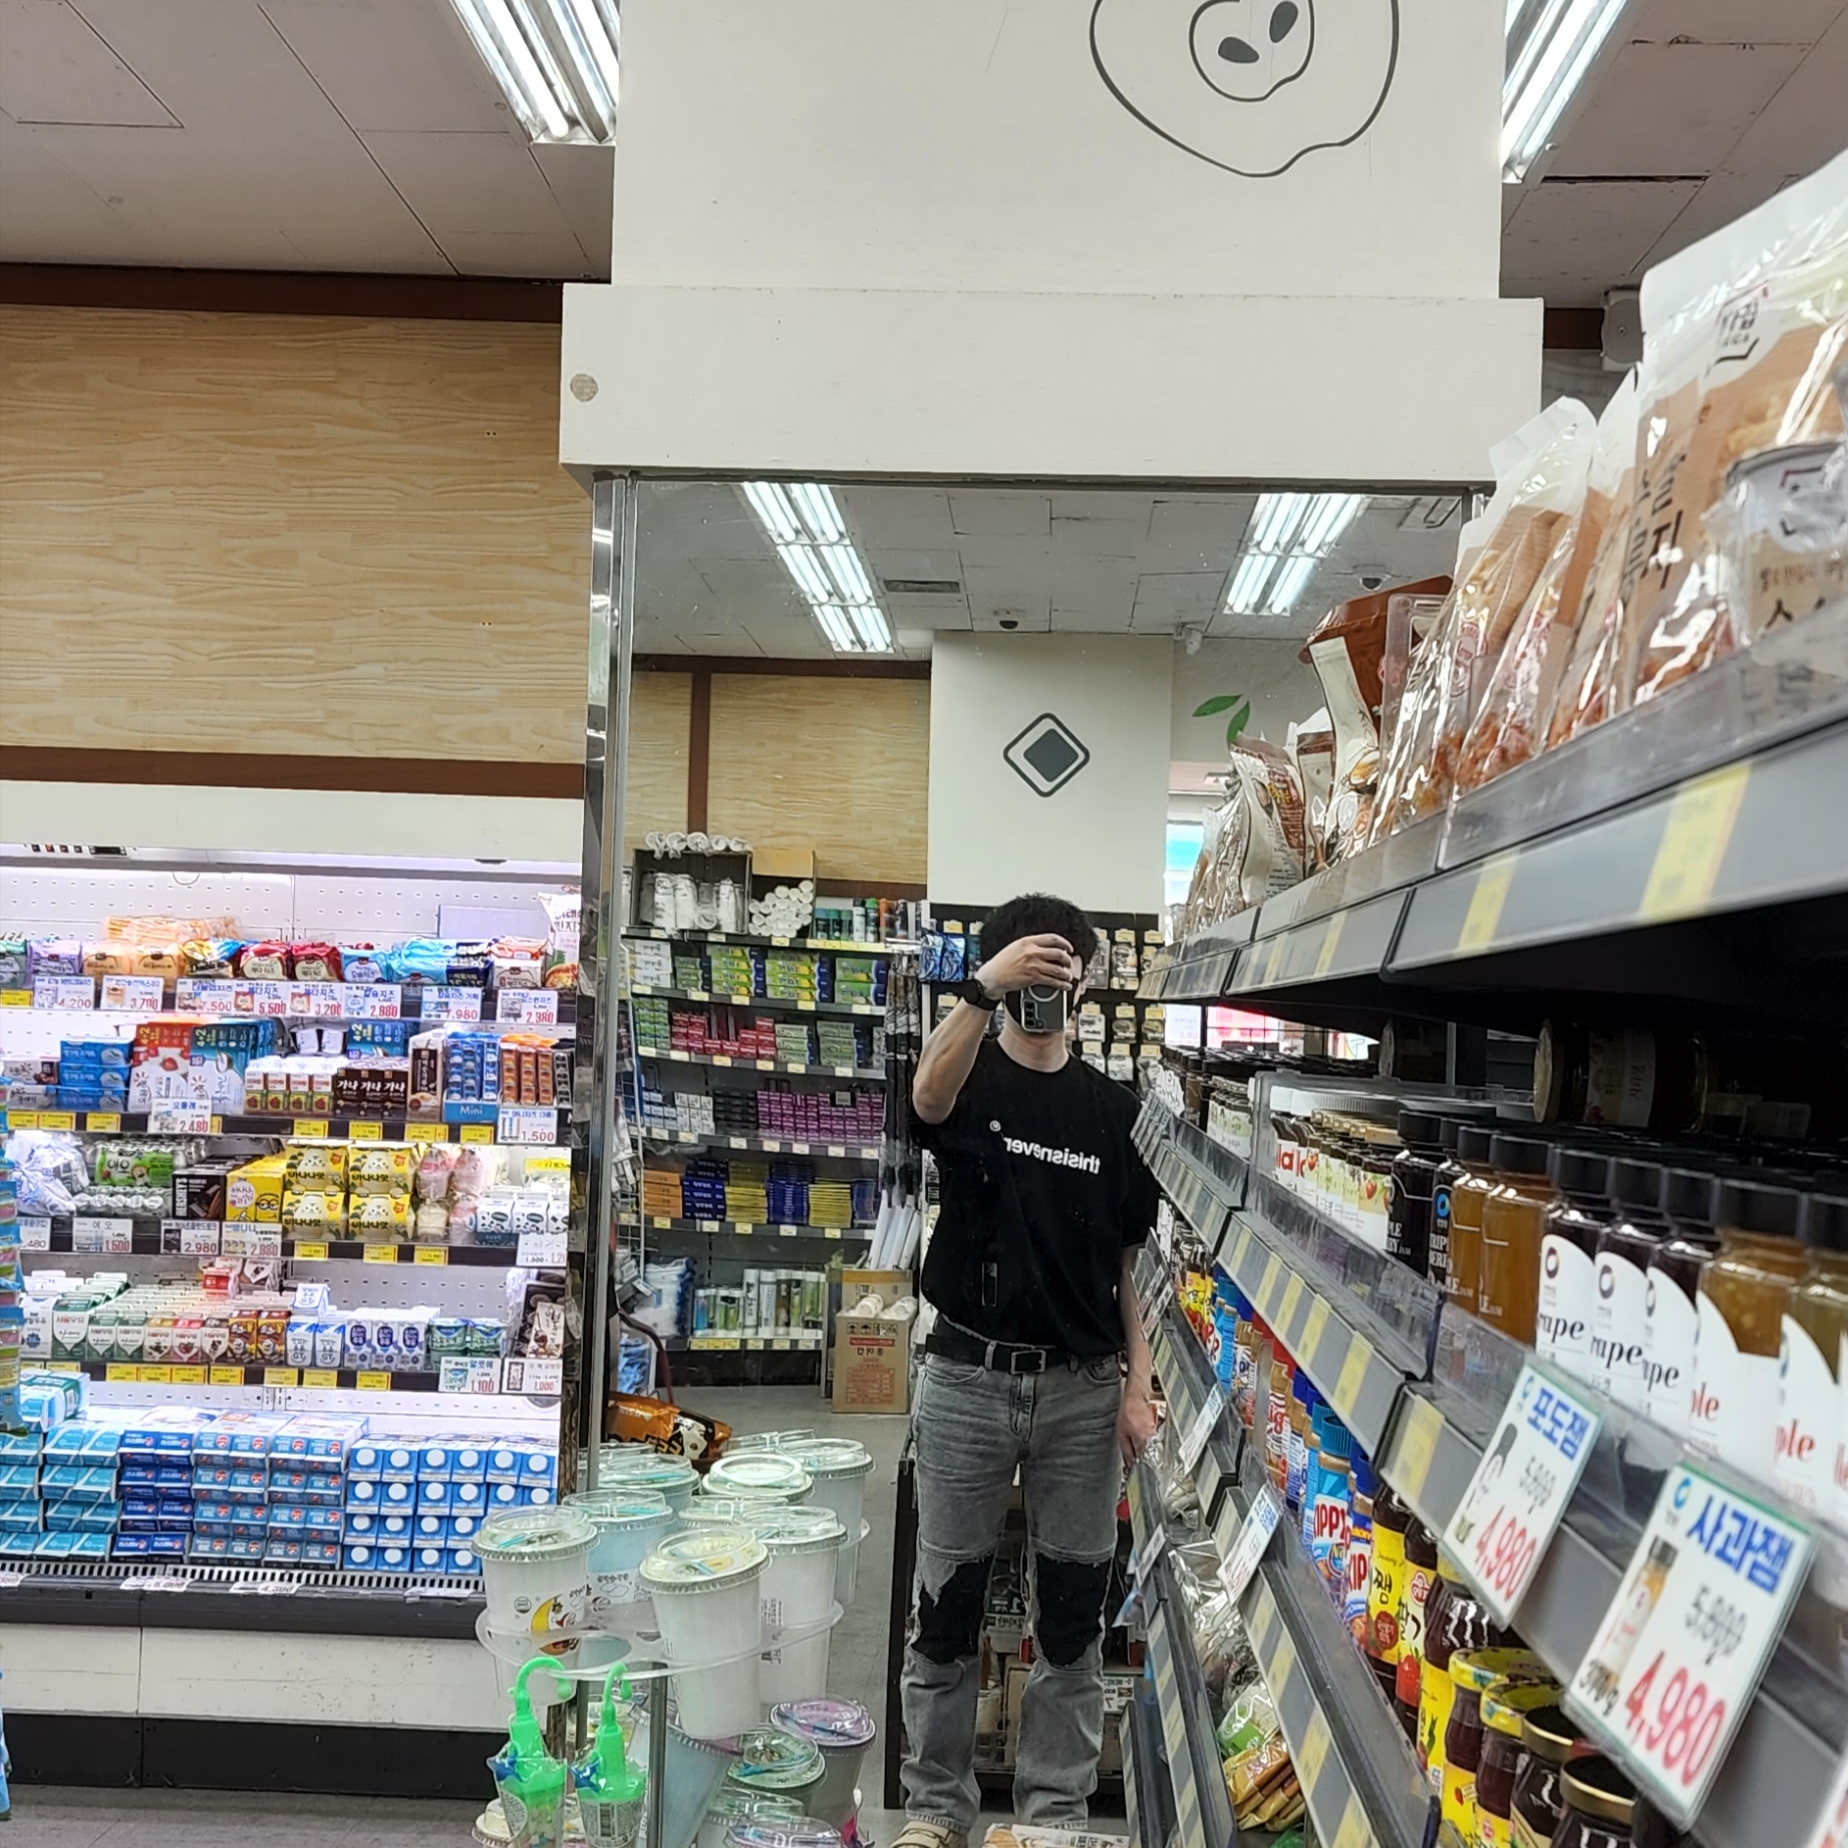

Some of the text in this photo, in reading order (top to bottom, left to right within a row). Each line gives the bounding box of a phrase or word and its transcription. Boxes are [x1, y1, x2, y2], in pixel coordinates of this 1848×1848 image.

[338, 1080, 359, 1091] 가나
[360, 1081, 382, 1092] 가나
[384, 1081, 405, 1092] 가나
[460, 1105, 484, 1116] Mini
[107, 1158, 131, 1173] 이오
[288, 1170, 325, 1180] 바나나맛
[352, 1173, 389, 1182] 바나나맛
[284, 1218, 321, 1227] 바나나맛
[352, 1220, 389, 1229] 바나나맛
[292, 1353, 308, 1362] GT
[321, 1354, 337, 1363] GT
[1526, 1387, 1592, 1462] 포도잼
[1685, 1493, 1797, 1598] 사과잼
[1475, 1504, 1539, 1604] 4,980
[1576, 1655, 1622, 1719] 370g
[1623, 1648, 1728, 1788] 4,980
